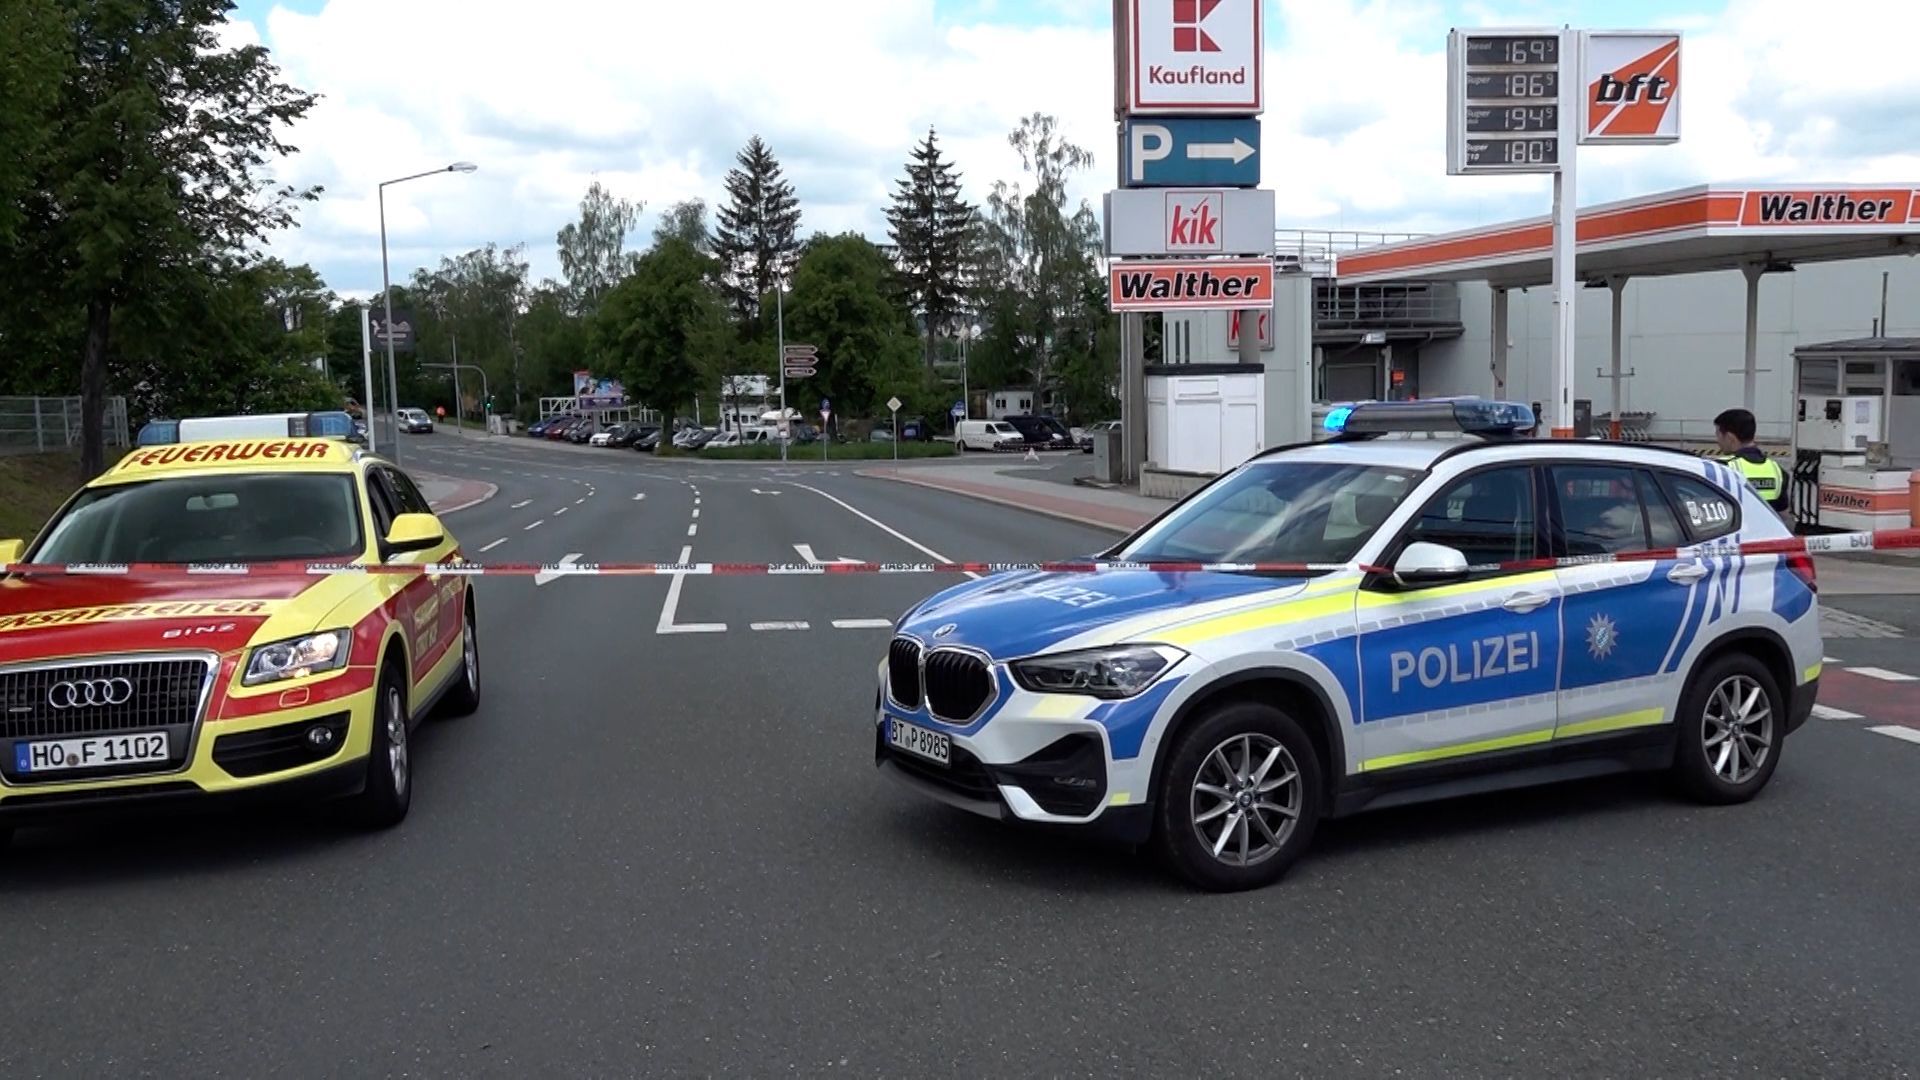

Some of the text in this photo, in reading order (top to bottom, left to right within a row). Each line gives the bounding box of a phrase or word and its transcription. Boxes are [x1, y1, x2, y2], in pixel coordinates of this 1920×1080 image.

[1149, 65, 1245, 84] Kaufland
[1595, 73, 1669, 104] bft
[1131, 125, 1173, 180] P
[1170, 198, 1218, 244] kik
[1759, 194, 1893, 222] Walther
[1119, 272, 1259, 299] Walther
[121, 441, 330, 470] FEUERWEHR
[1702, 501, 1728, 521] 110
[1823, 492, 1870, 508] Walther
[162, 622, 237, 639] BINZ
[1390, 631, 1539, 693] POLIZEI
[32, 735, 165, 767] HO F 1102
[892, 721, 948, 759] BT P 8985
